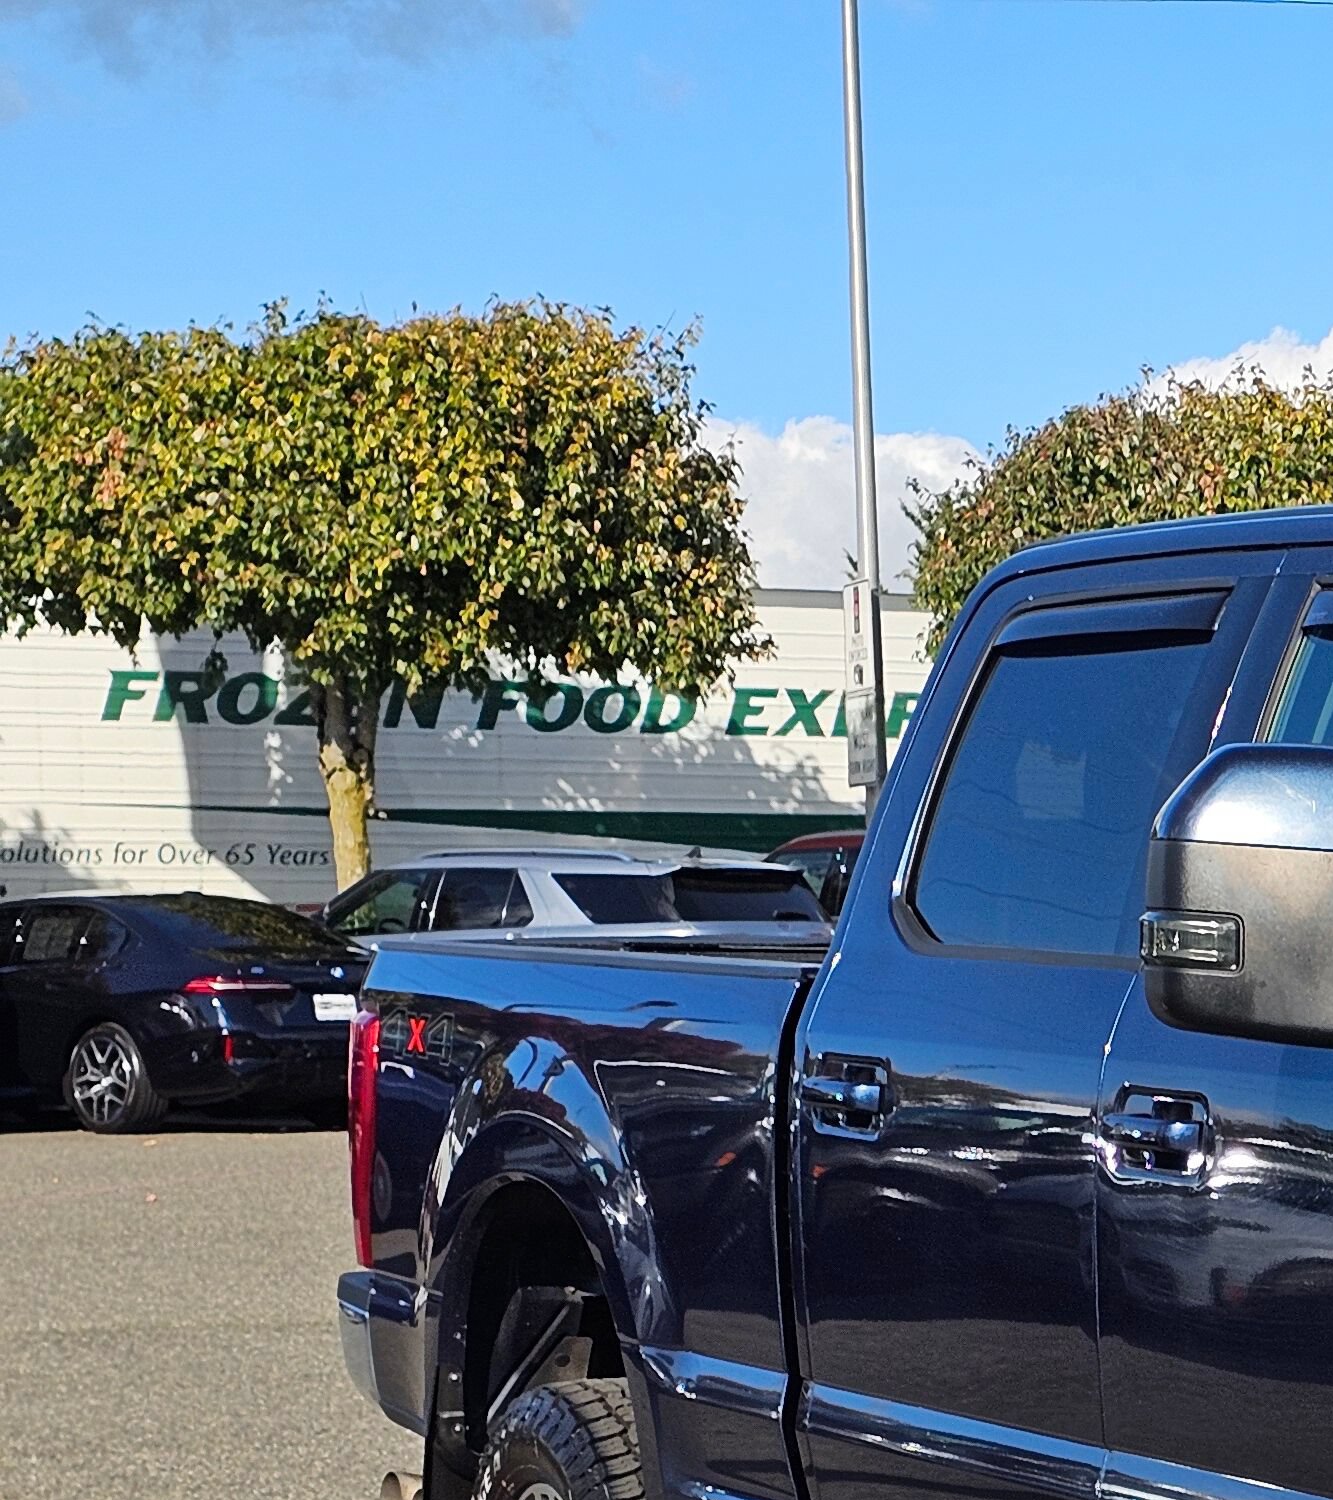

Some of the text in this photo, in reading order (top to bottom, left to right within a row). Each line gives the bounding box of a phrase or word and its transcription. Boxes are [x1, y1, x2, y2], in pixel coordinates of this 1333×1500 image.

[101, 670, 447, 729] FROZN
[475, 680, 698, 735] FOOD
[0, 841, 331, 866] olutions for Over 65 Years
